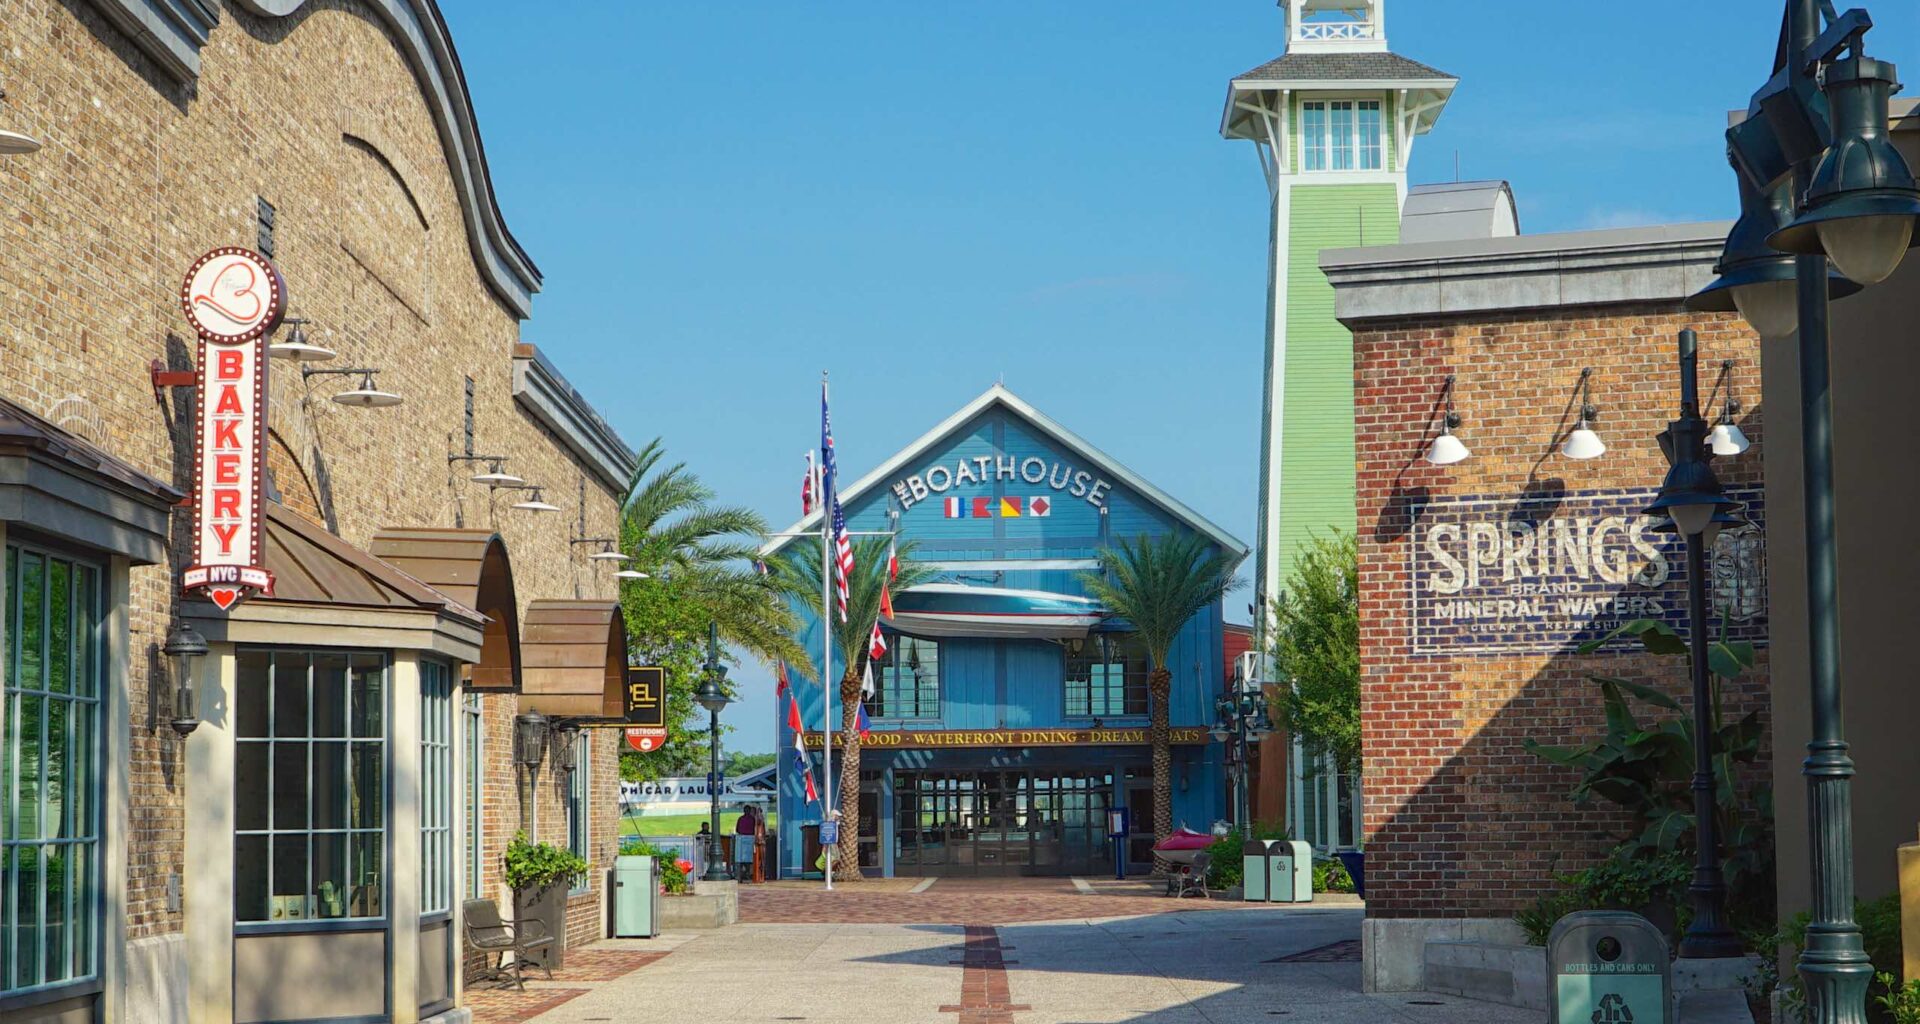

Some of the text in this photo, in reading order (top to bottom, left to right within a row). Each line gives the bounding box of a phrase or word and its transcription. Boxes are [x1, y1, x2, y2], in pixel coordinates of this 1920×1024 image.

[210, 350, 244, 555] BAKERY
[892, 455, 1112, 510] THE BOATHOUSE
[1424, 515, 1669, 594] SPRINGS
[210, 566, 238, 583] NYC
[1511, 582, 1582, 595] BRAND
[1435, 597, 1665, 619] MINERAL WATERS
[1471, 623, 1517, 632] CLEAR
[1545, 621, 1630, 631] REFRESHIN
[914, 731, 1015, 745] WATERFRONT
[1021, 731, 1078, 743] DINING
[1091, 730, 1144, 742] DREAM
[1565, 963, 1656, 972] BOTTLES AND CANS ONLY
